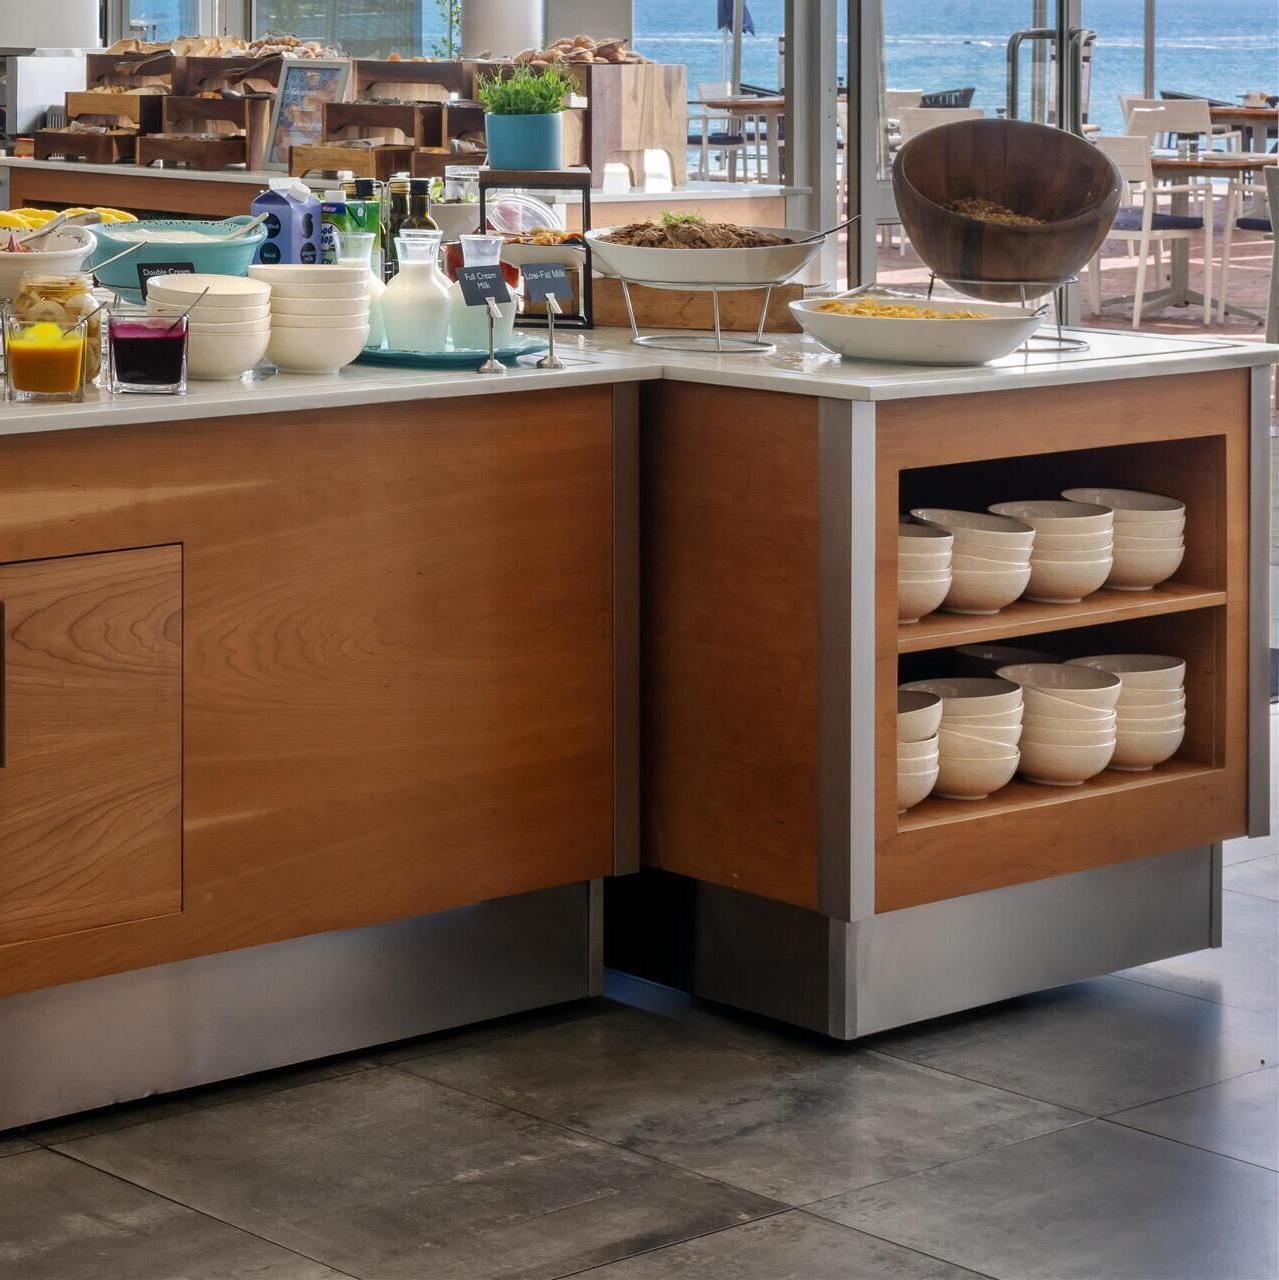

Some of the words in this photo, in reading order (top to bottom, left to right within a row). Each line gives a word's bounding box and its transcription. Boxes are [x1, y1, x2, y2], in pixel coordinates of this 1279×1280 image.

[143, 268, 167, 276] Double
[523, 271, 552, 280] Low-Fat
[552, 270, 566, 278] Milk
[465, 272, 476, 281] Full
[476, 272, 497, 280] Cream
[477, 281, 491, 289] Milk
